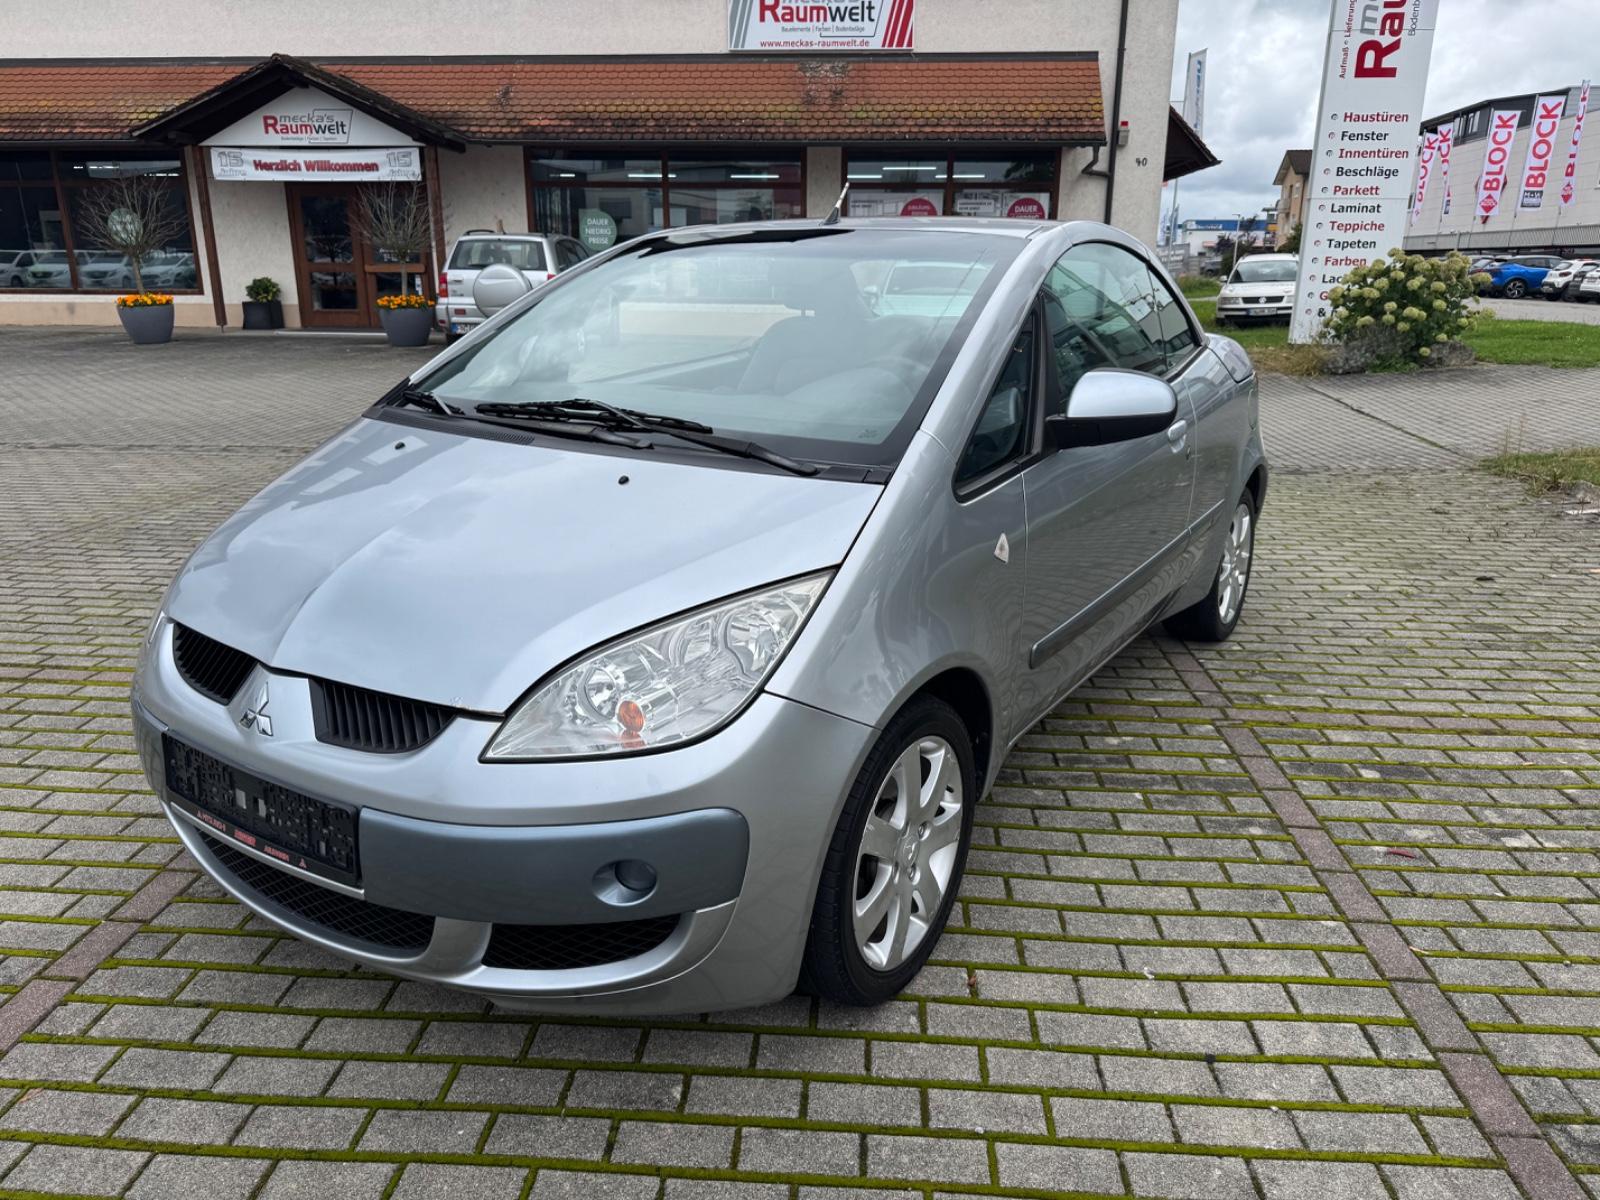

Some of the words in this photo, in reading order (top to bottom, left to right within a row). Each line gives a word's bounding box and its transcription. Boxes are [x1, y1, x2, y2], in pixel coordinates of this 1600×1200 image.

[759, 0, 875, 22] Raumwelt
[760, 39, 870, 48] www.meckas-raumwelt.de
[1339, 46, 1349, 79] Aufmaß
[280, 112, 334, 123] mecka's
[1343, 112, 1409, 122] Haustüren
[262, 115, 346, 134] Raumwelt
[1341, 131, 1389, 141] Fenster
[1525, 101, 1563, 190] BLOCK
[1338, 148, 1409, 158] Innentüren
[1483, 113, 1518, 192] BLOCK
[253, 160, 302, 171] Herzlich
[304, 160, 379, 172] Willkommen
[1336, 166, 1399, 179] Beschläge
[1333, 185, 1380, 195] Parkett
[1014, 205, 1038, 213] DAUER
[1330, 203, 1381, 213] Laminat
[1329, 221, 1385, 233] Teppiche
[1327, 239, 1377, 251] Tapeten
[1324, 256, 1367, 266] Farben
[1322, 274, 1343, 284] Lac
